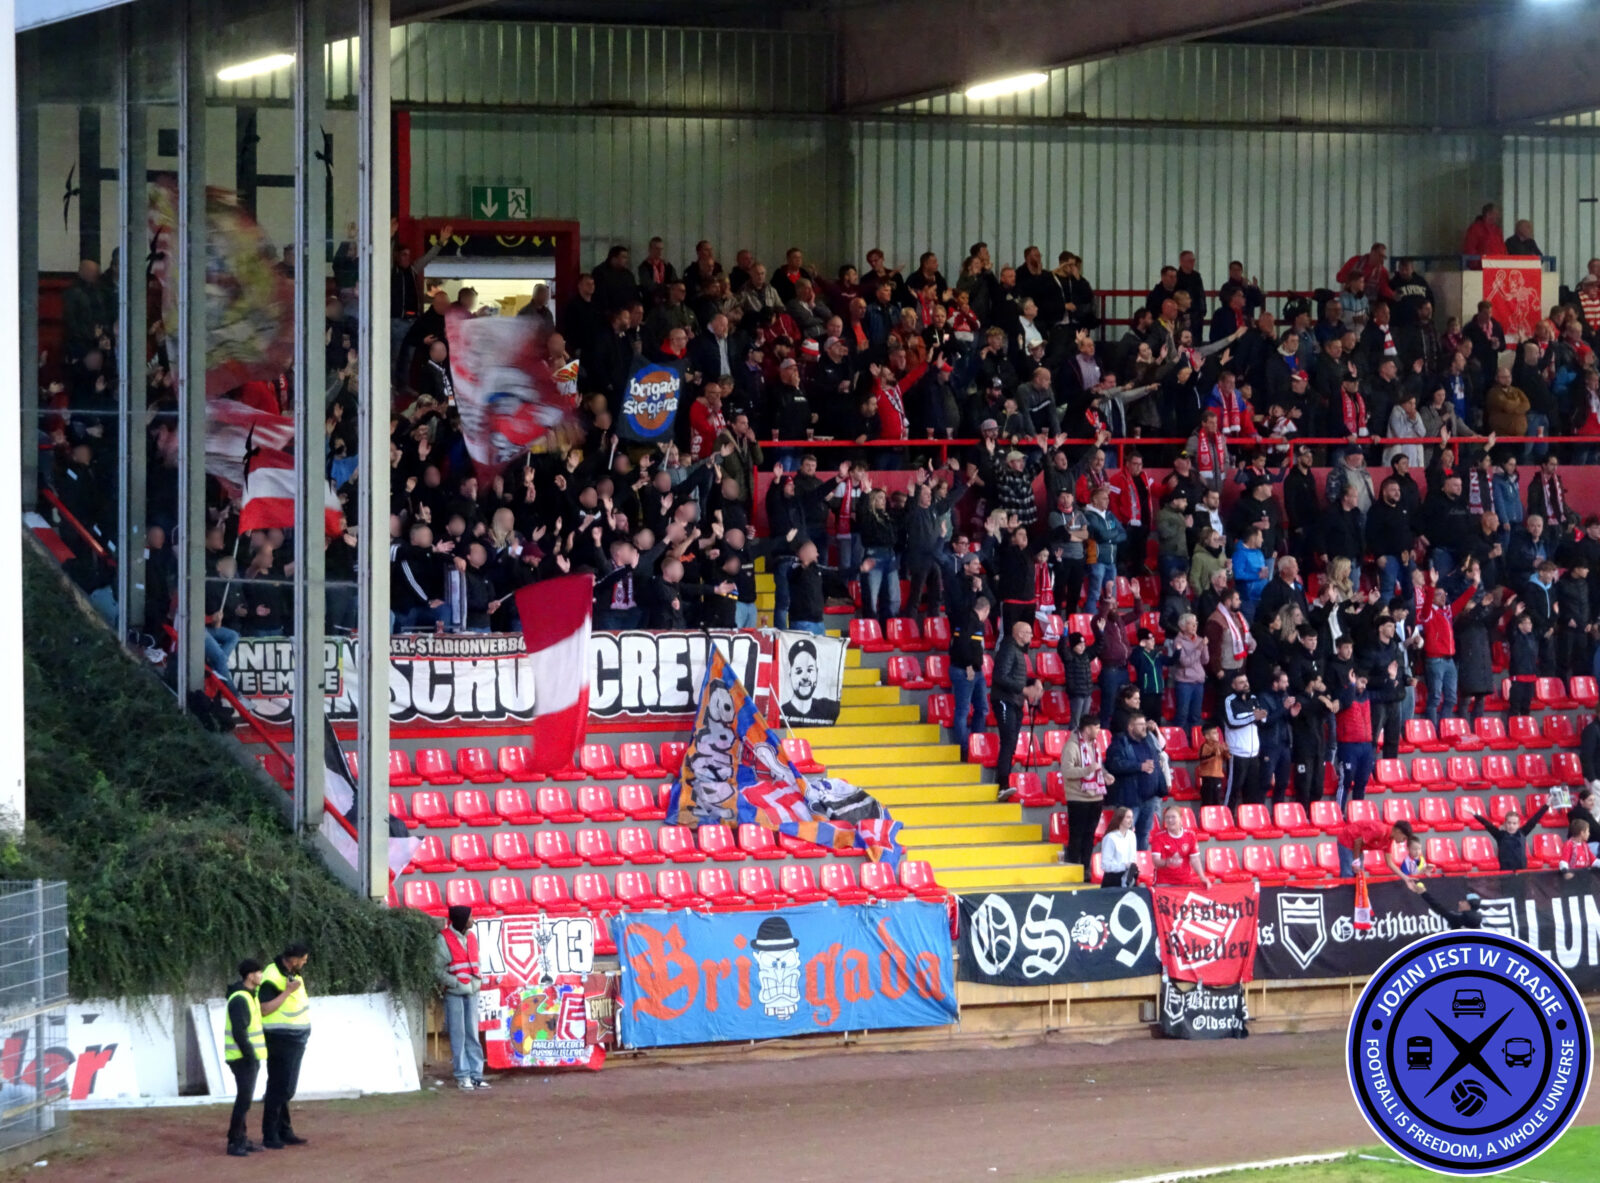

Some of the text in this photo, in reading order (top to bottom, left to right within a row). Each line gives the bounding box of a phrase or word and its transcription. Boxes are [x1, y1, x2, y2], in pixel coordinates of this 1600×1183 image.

[552, 919, 594, 974] 13
[1109, 890, 1161, 969] 9
[1164, 930, 1250, 962] Rebellen
